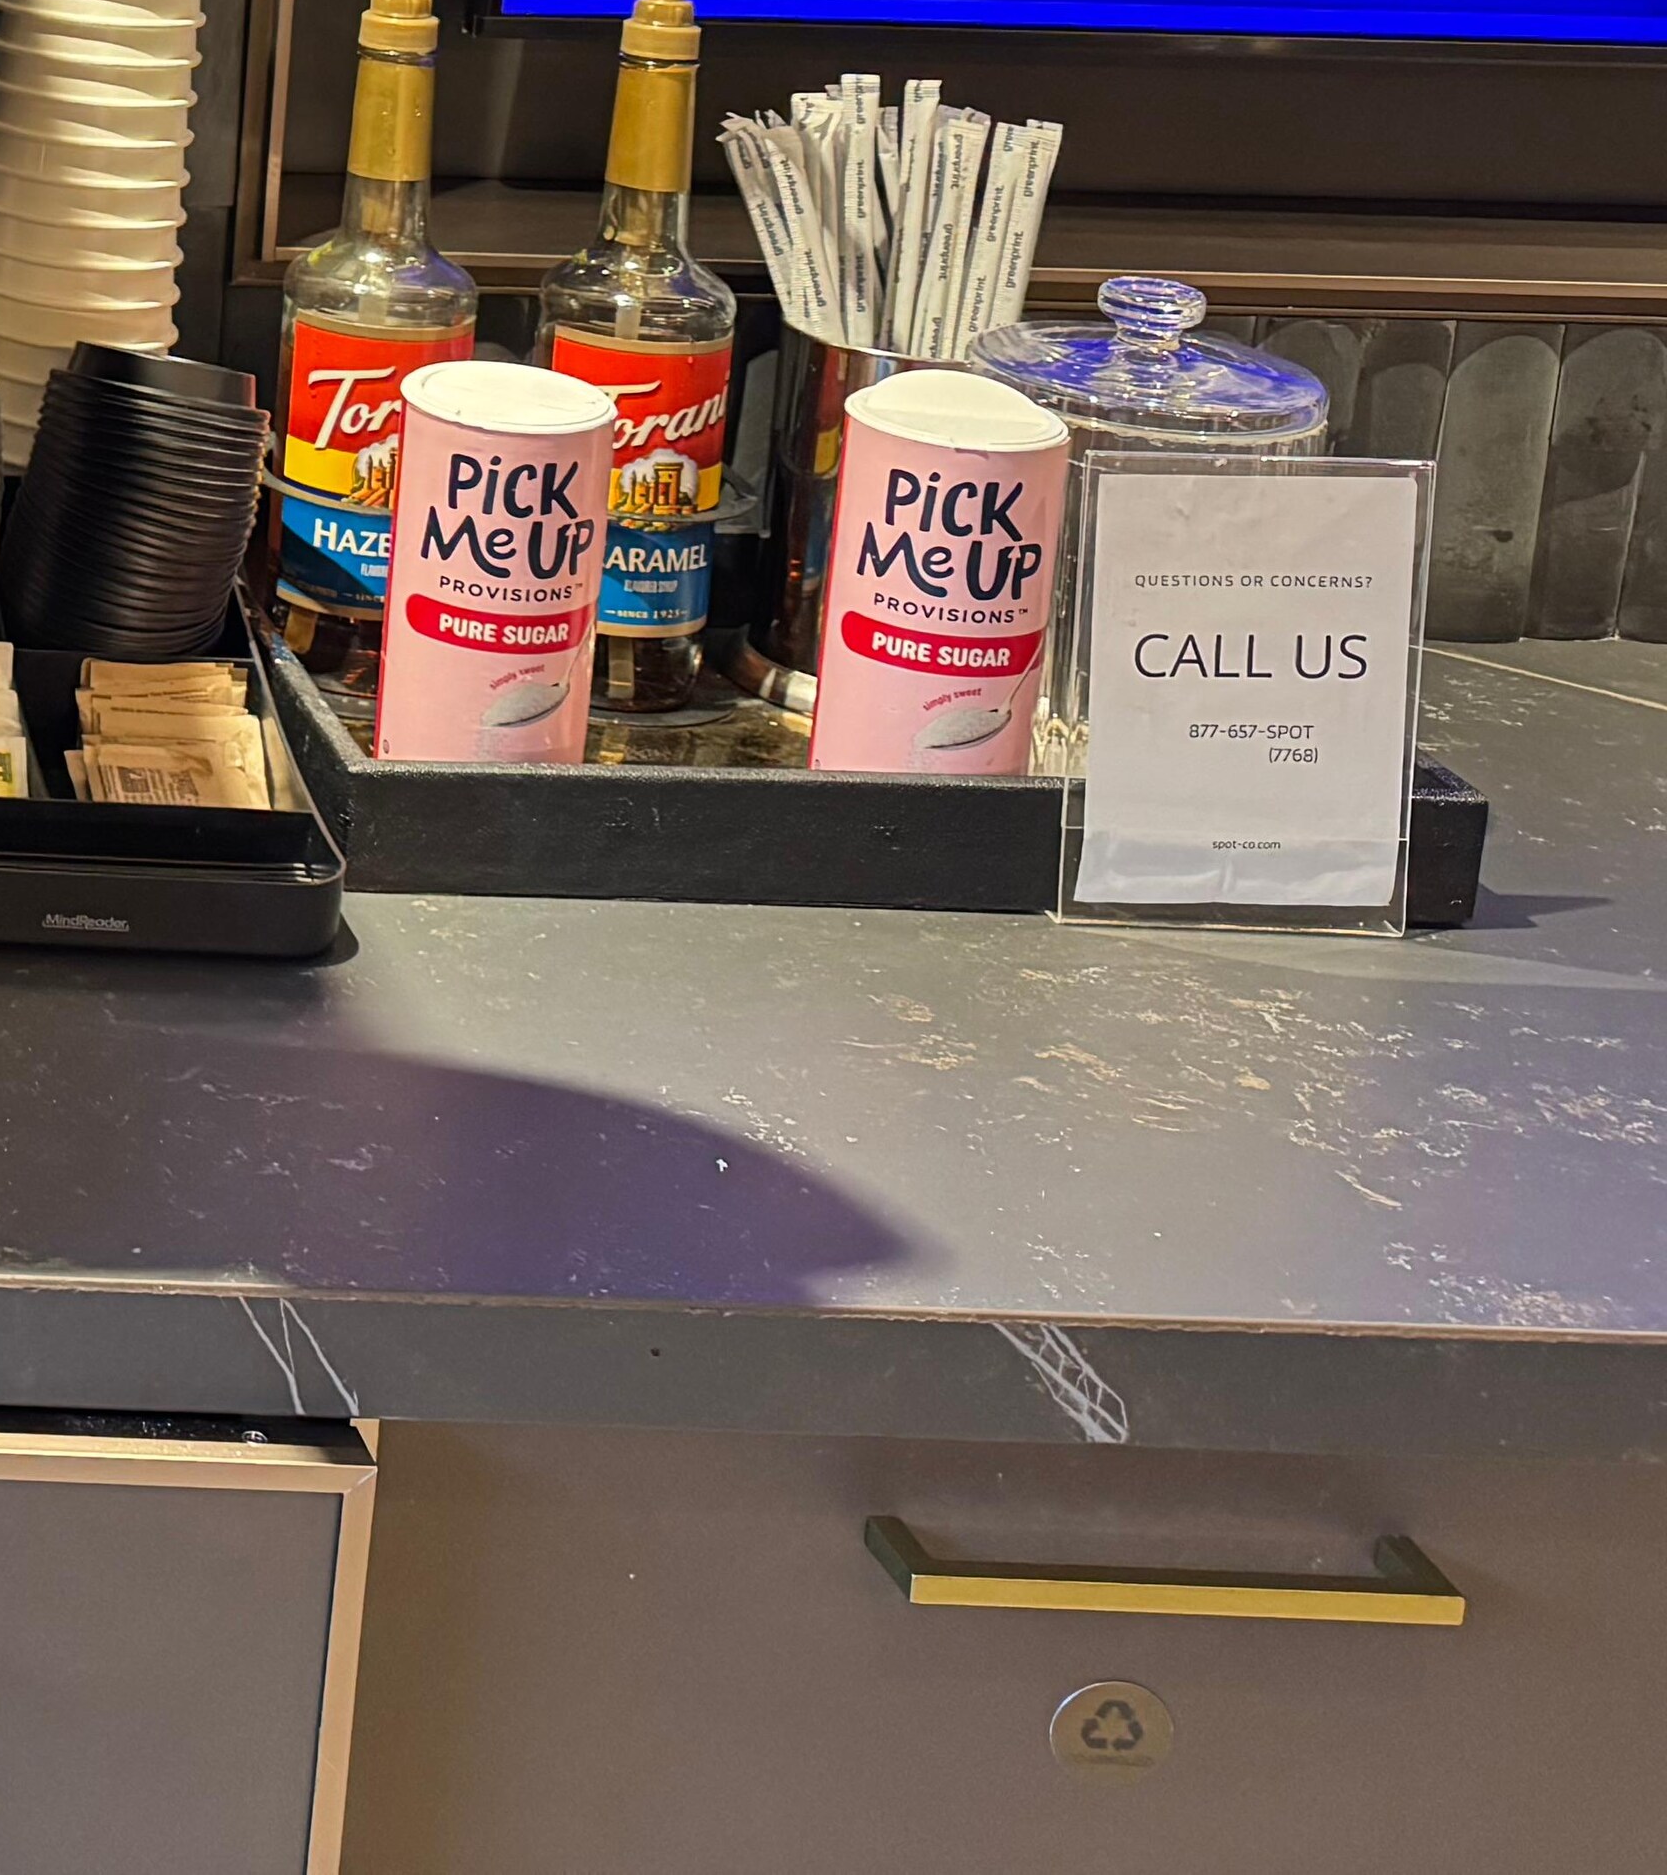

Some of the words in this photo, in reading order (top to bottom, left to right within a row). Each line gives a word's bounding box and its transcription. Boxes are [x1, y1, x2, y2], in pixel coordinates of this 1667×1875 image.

[308, 365, 401, 450] Tor
[313, 518, 393, 557] HAZE
[420, 505, 516, 579] Me
[528, 518, 595, 580] UP
[603, 544, 707, 573] ARAMEL
[857, 521, 954, 598] Me
[967, 541, 1042, 601] UP
[1135, 575, 1234, 588] QUESTIONS
[1241, 575, 1263, 588] OR
[1270, 575, 1372, 589] CONCERNS?
[439, 613, 496, 644] PURE
[502, 617, 569, 645] SUGAR
[871, 633, 931, 663] PURE
[938, 642, 1011, 668] SUGAR
[1135, 634, 1272, 679] CALL
[1295, 634, 1368, 681] US
[1189, 724, 1314, 740] 877-657-SPOT
[1268, 748, 1318, 765] (7768)
